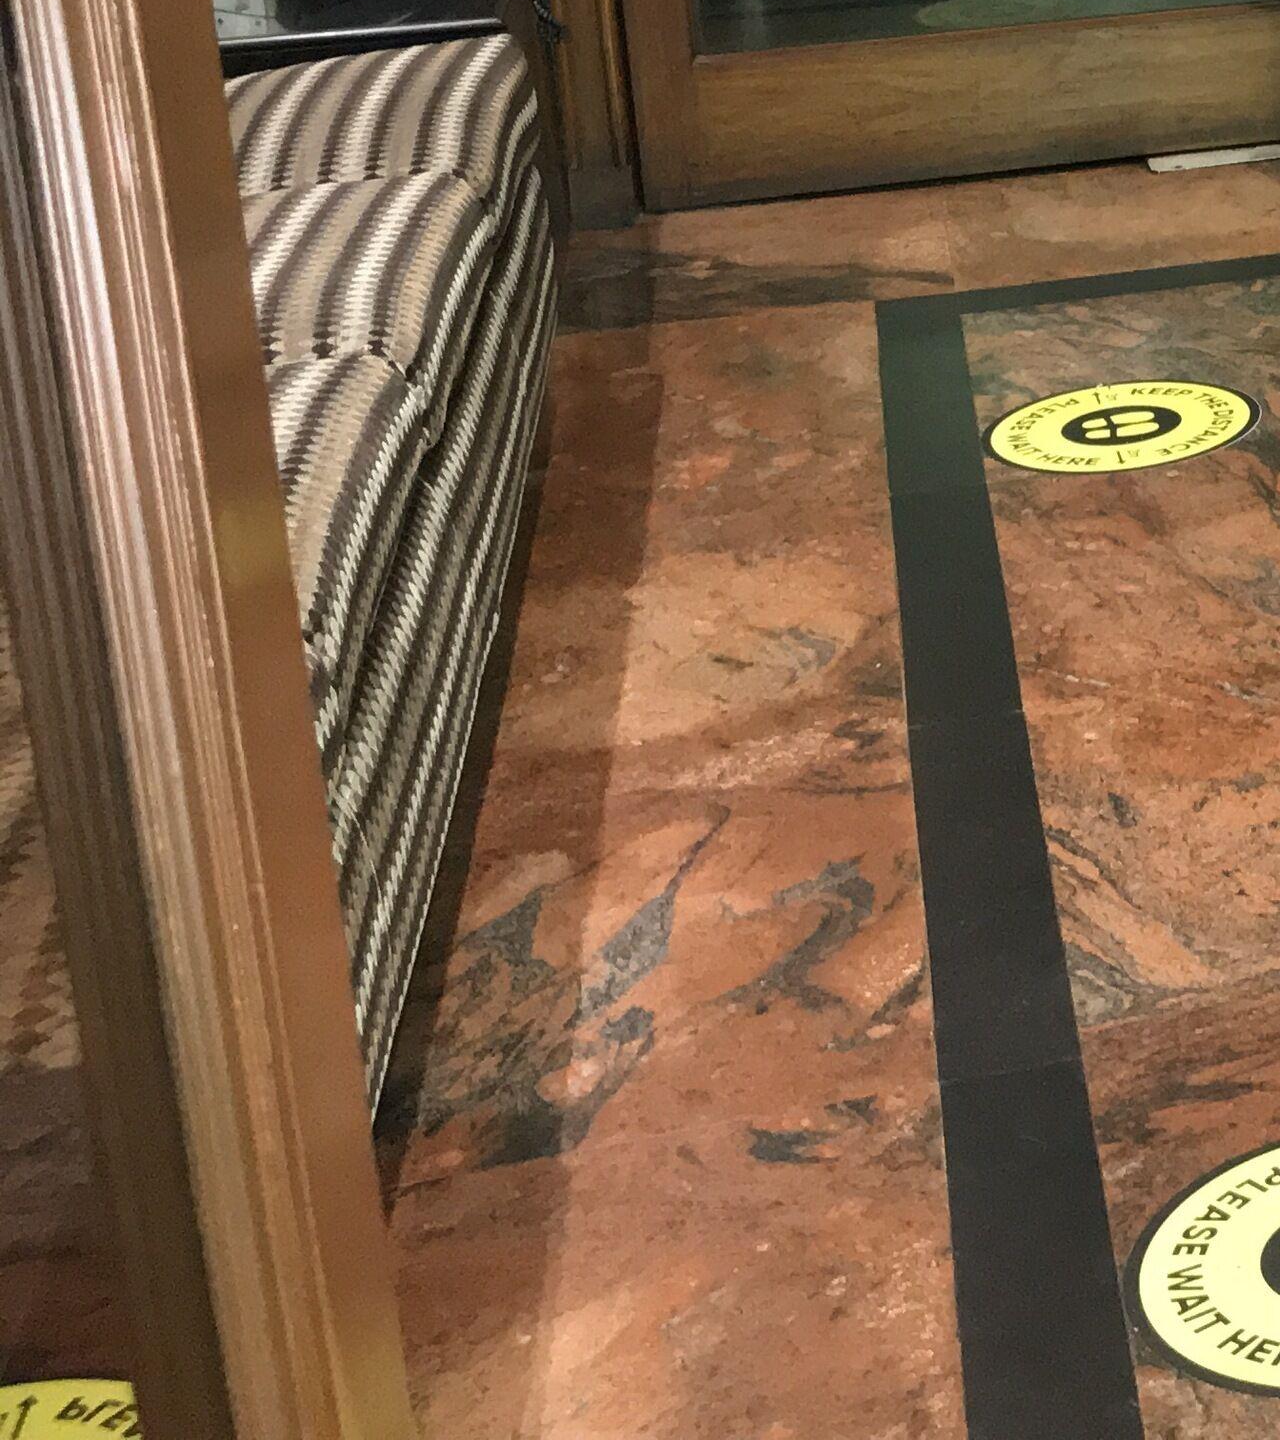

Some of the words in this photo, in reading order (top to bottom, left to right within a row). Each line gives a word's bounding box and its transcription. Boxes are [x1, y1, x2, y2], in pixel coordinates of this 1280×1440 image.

[1130, 387, 1194, 397] KEEP
[1195, 392, 1229, 410] THE
[1009, 398, 1081, 432] PLEASE
[1157, 408, 1235, 457] DISTANCE
[1006, 434, 1042, 457] WAIT
[1039, 453, 1101, 466] HERE
[1166, 1262, 1232, 1335] WAIT
